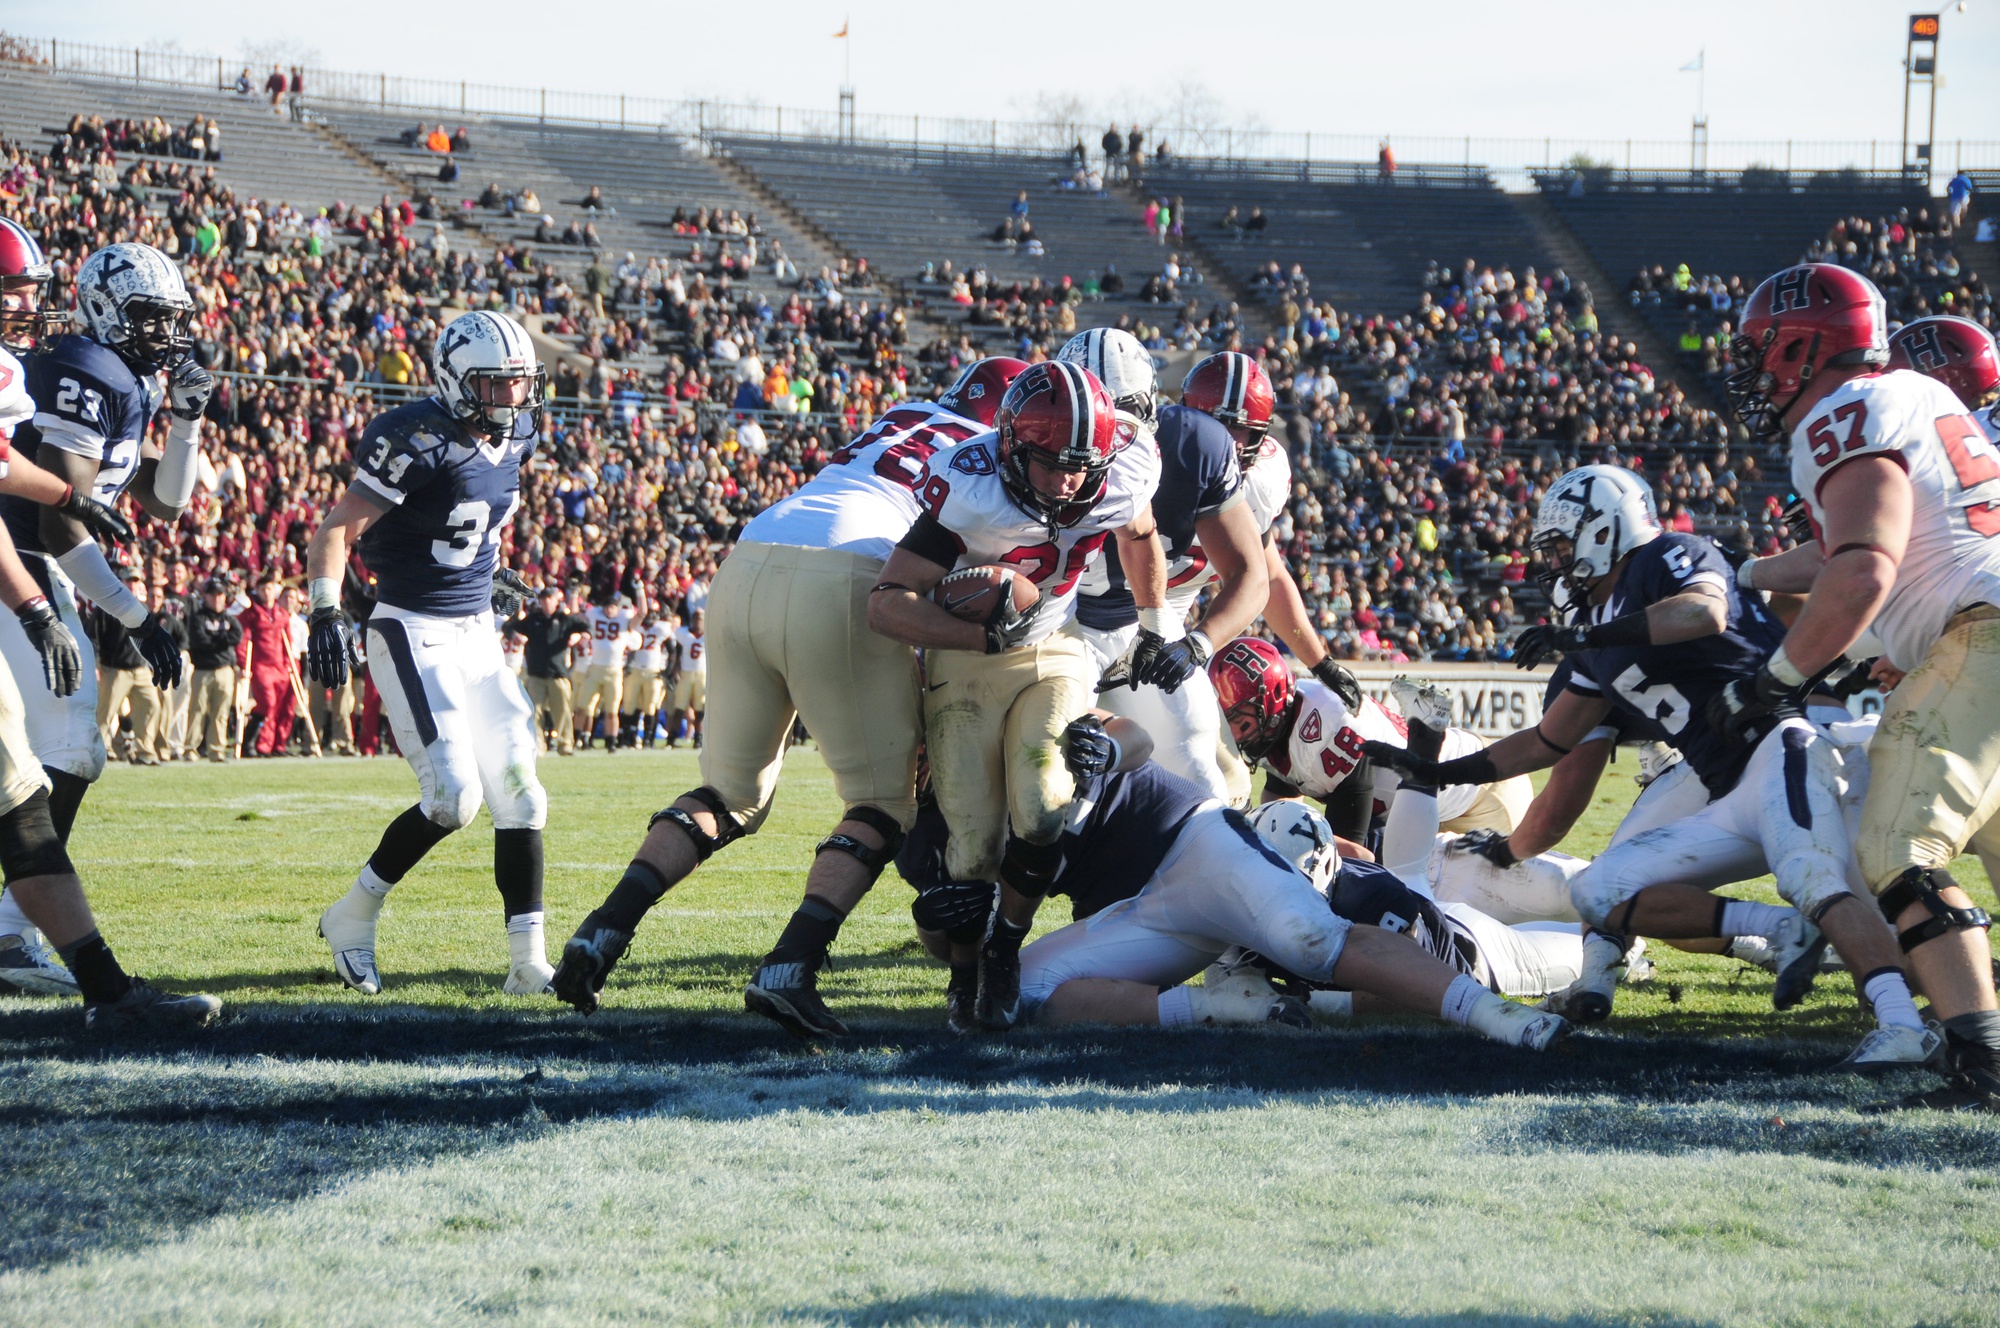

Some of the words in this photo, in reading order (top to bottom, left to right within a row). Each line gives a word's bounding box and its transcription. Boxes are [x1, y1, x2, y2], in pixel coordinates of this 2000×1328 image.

[94, 252, 136, 292] Y
[1771, 267, 1816, 315] H
[439, 327, 472, 370] Y
[1901, 325, 1948, 371] H
[57, 377, 103, 422] 23
[1001, 365, 1053, 418] H
[1806, 399, 1869, 467] 57
[369, 436, 414, 484] 34
[912, 462, 950, 520] 29
[1558, 475, 1606, 524] Y
[1661, 544, 1695, 579] 5
[595, 620, 619, 640] 59
[1224, 642, 1271, 683] H
[1320, 726, 1366, 778] 48
[759, 962, 806, 989] NIKE
